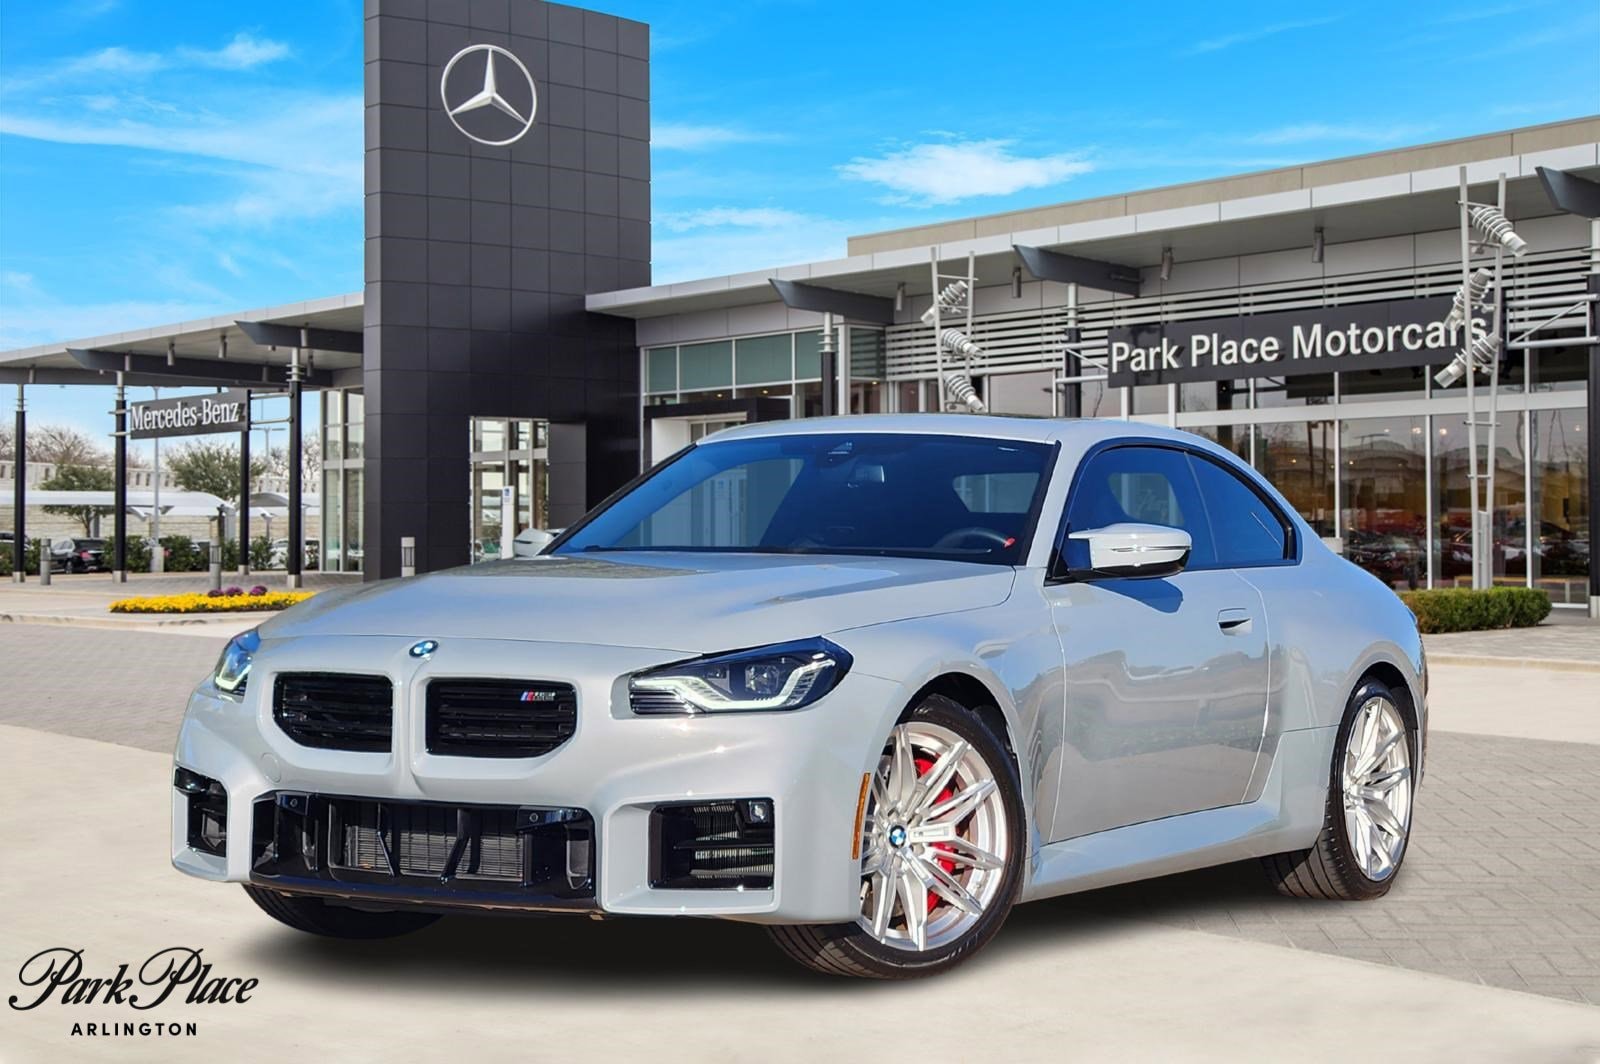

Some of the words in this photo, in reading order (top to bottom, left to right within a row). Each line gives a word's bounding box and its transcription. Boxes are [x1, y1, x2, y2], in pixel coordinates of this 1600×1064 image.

[1111, 338, 1179, 373] Park
[1191, 332, 1280, 367] Place
[131, 398, 240, 431] Mercedes-Benz
